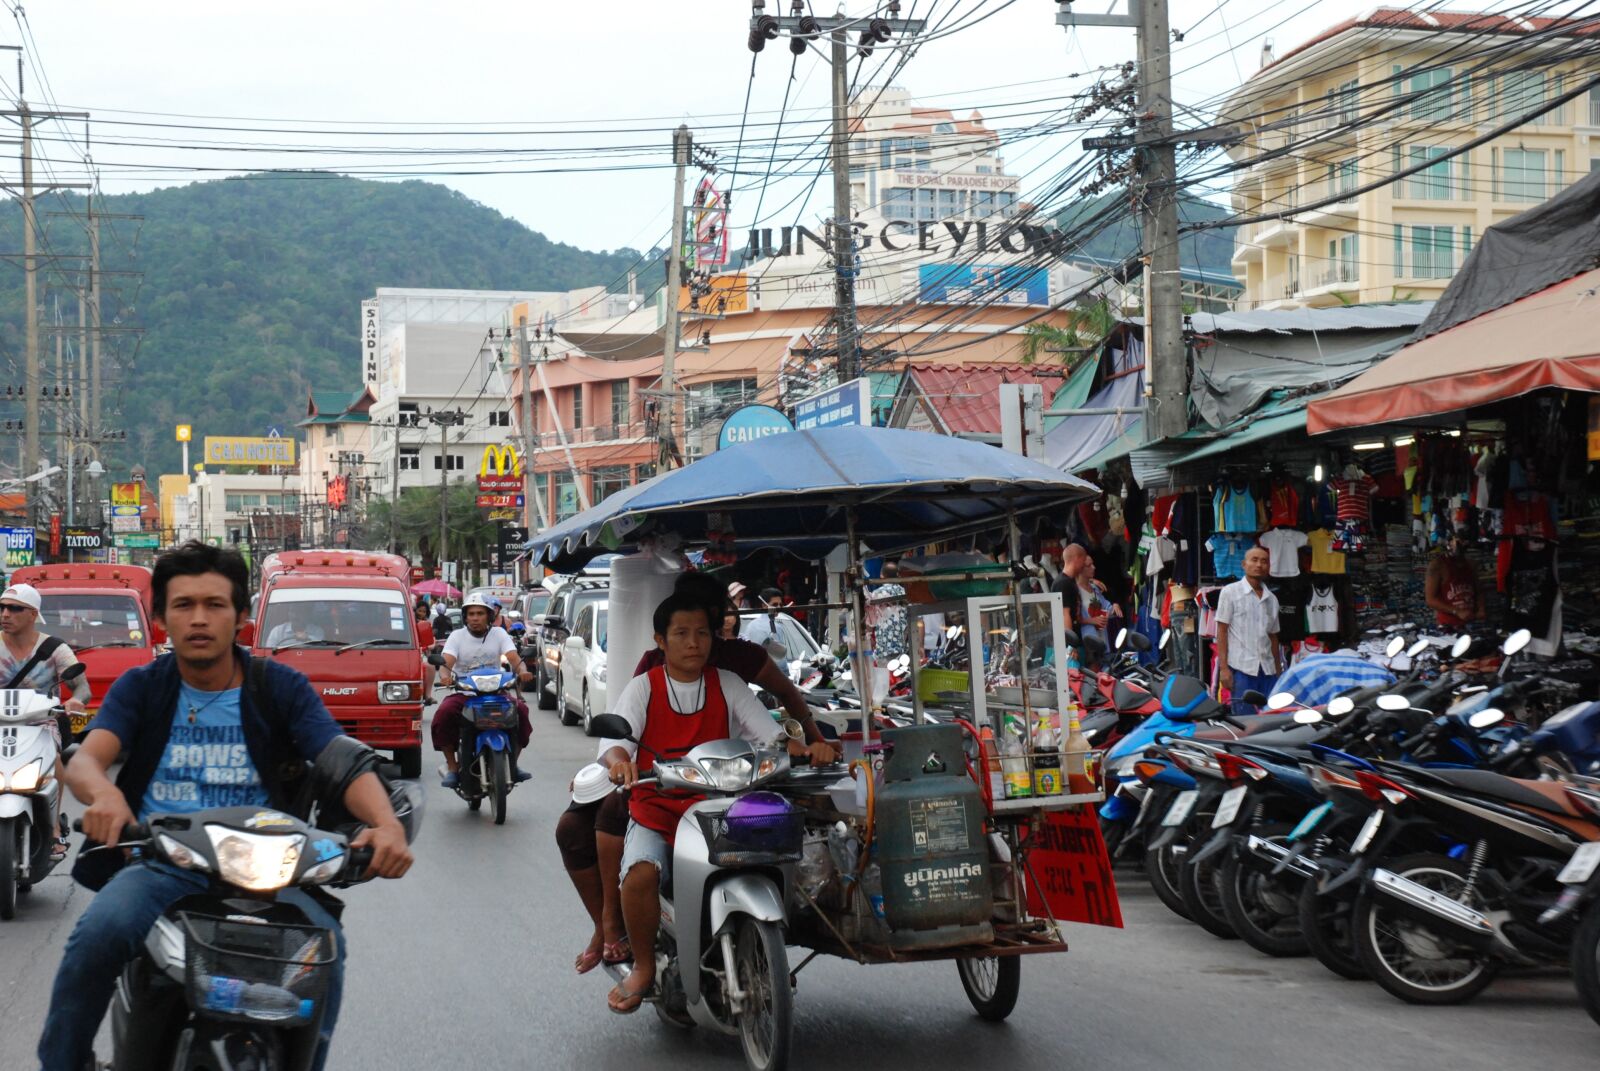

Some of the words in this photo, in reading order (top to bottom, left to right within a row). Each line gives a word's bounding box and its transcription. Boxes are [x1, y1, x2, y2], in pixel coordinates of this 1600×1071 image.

[898, 174, 914, 184] THE
[917, 175, 945, 186] ROYAL
[947, 176, 988, 187] PARADISE
[991, 178, 1019, 189] HOTEL
[367, 309, 376, 349] SAND
[367, 352, 377, 381] INN
[247, 442, 290, 461] HOTEL
[66, 535, 100, 547] TATTOO
[323, 687, 357, 696] HIJET
[170, 744, 247, 767] BOWS
